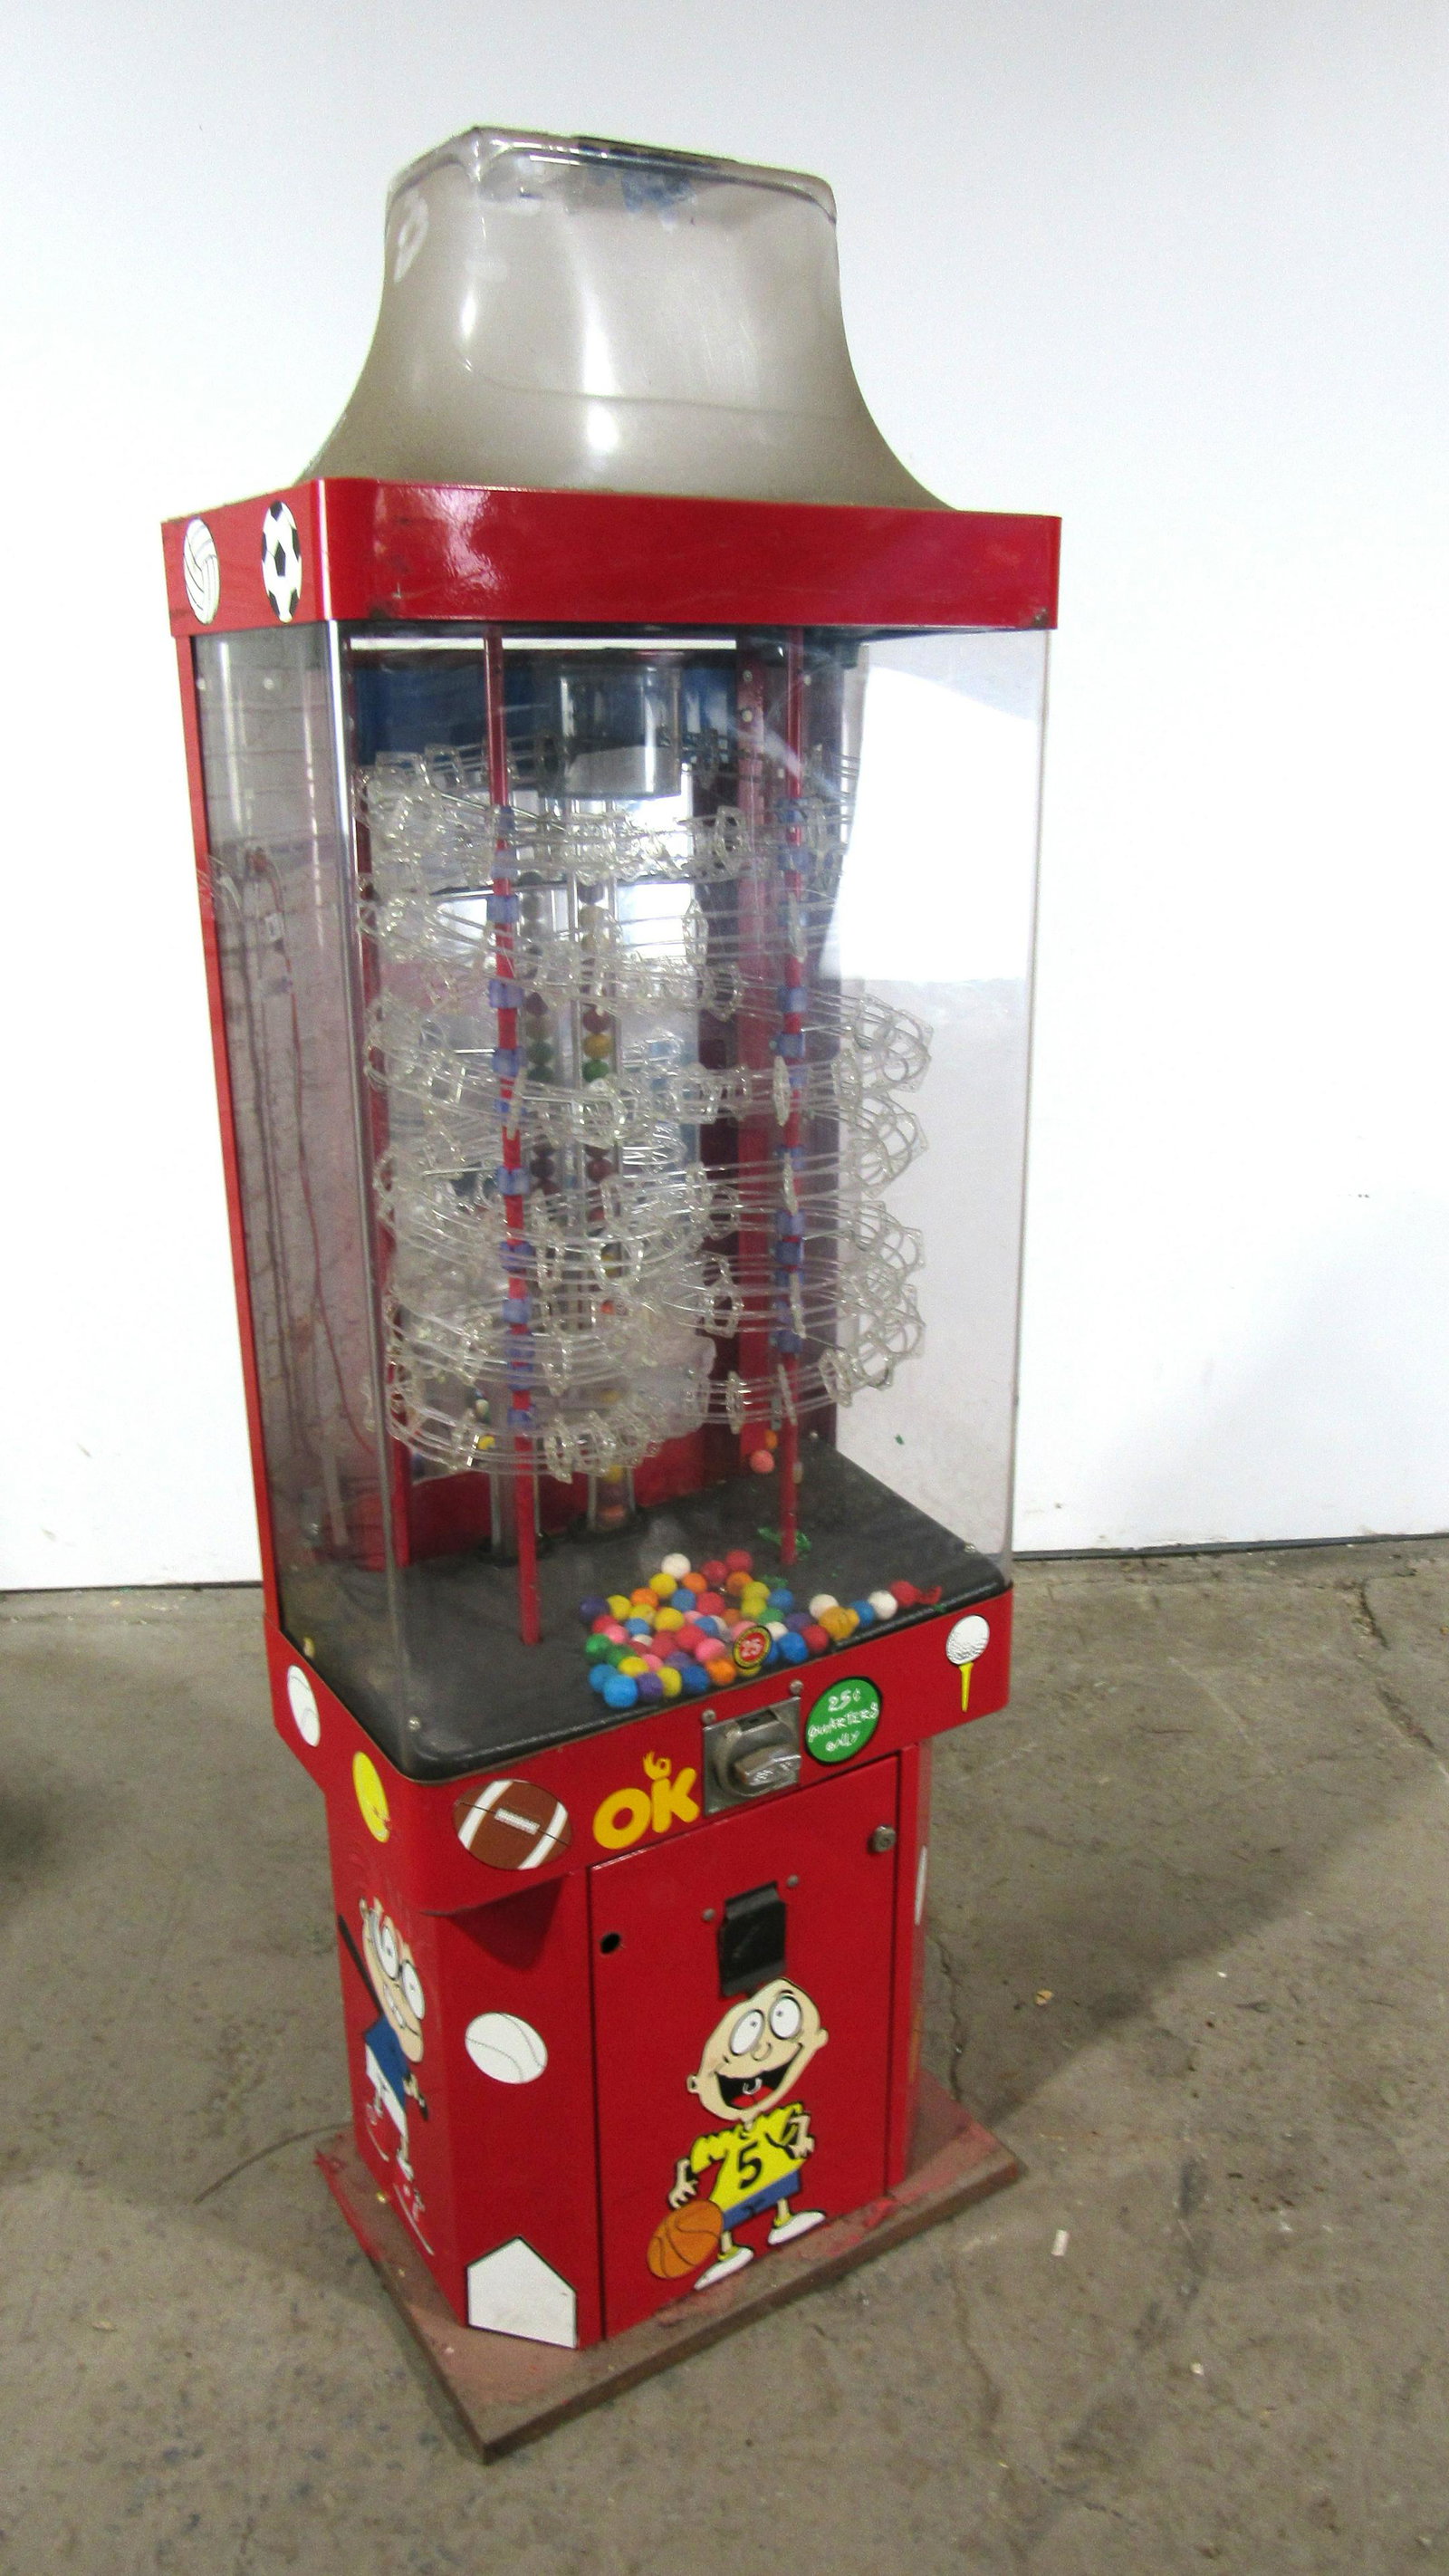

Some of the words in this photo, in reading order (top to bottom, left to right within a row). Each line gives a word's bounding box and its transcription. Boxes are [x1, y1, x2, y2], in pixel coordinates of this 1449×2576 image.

[808, 1702, 879, 1743] QUARTERS
[825, 1730, 860, 1752] ONLY
[592, 1766, 700, 1850] OK
[738, 2141, 762, 2189] 5
